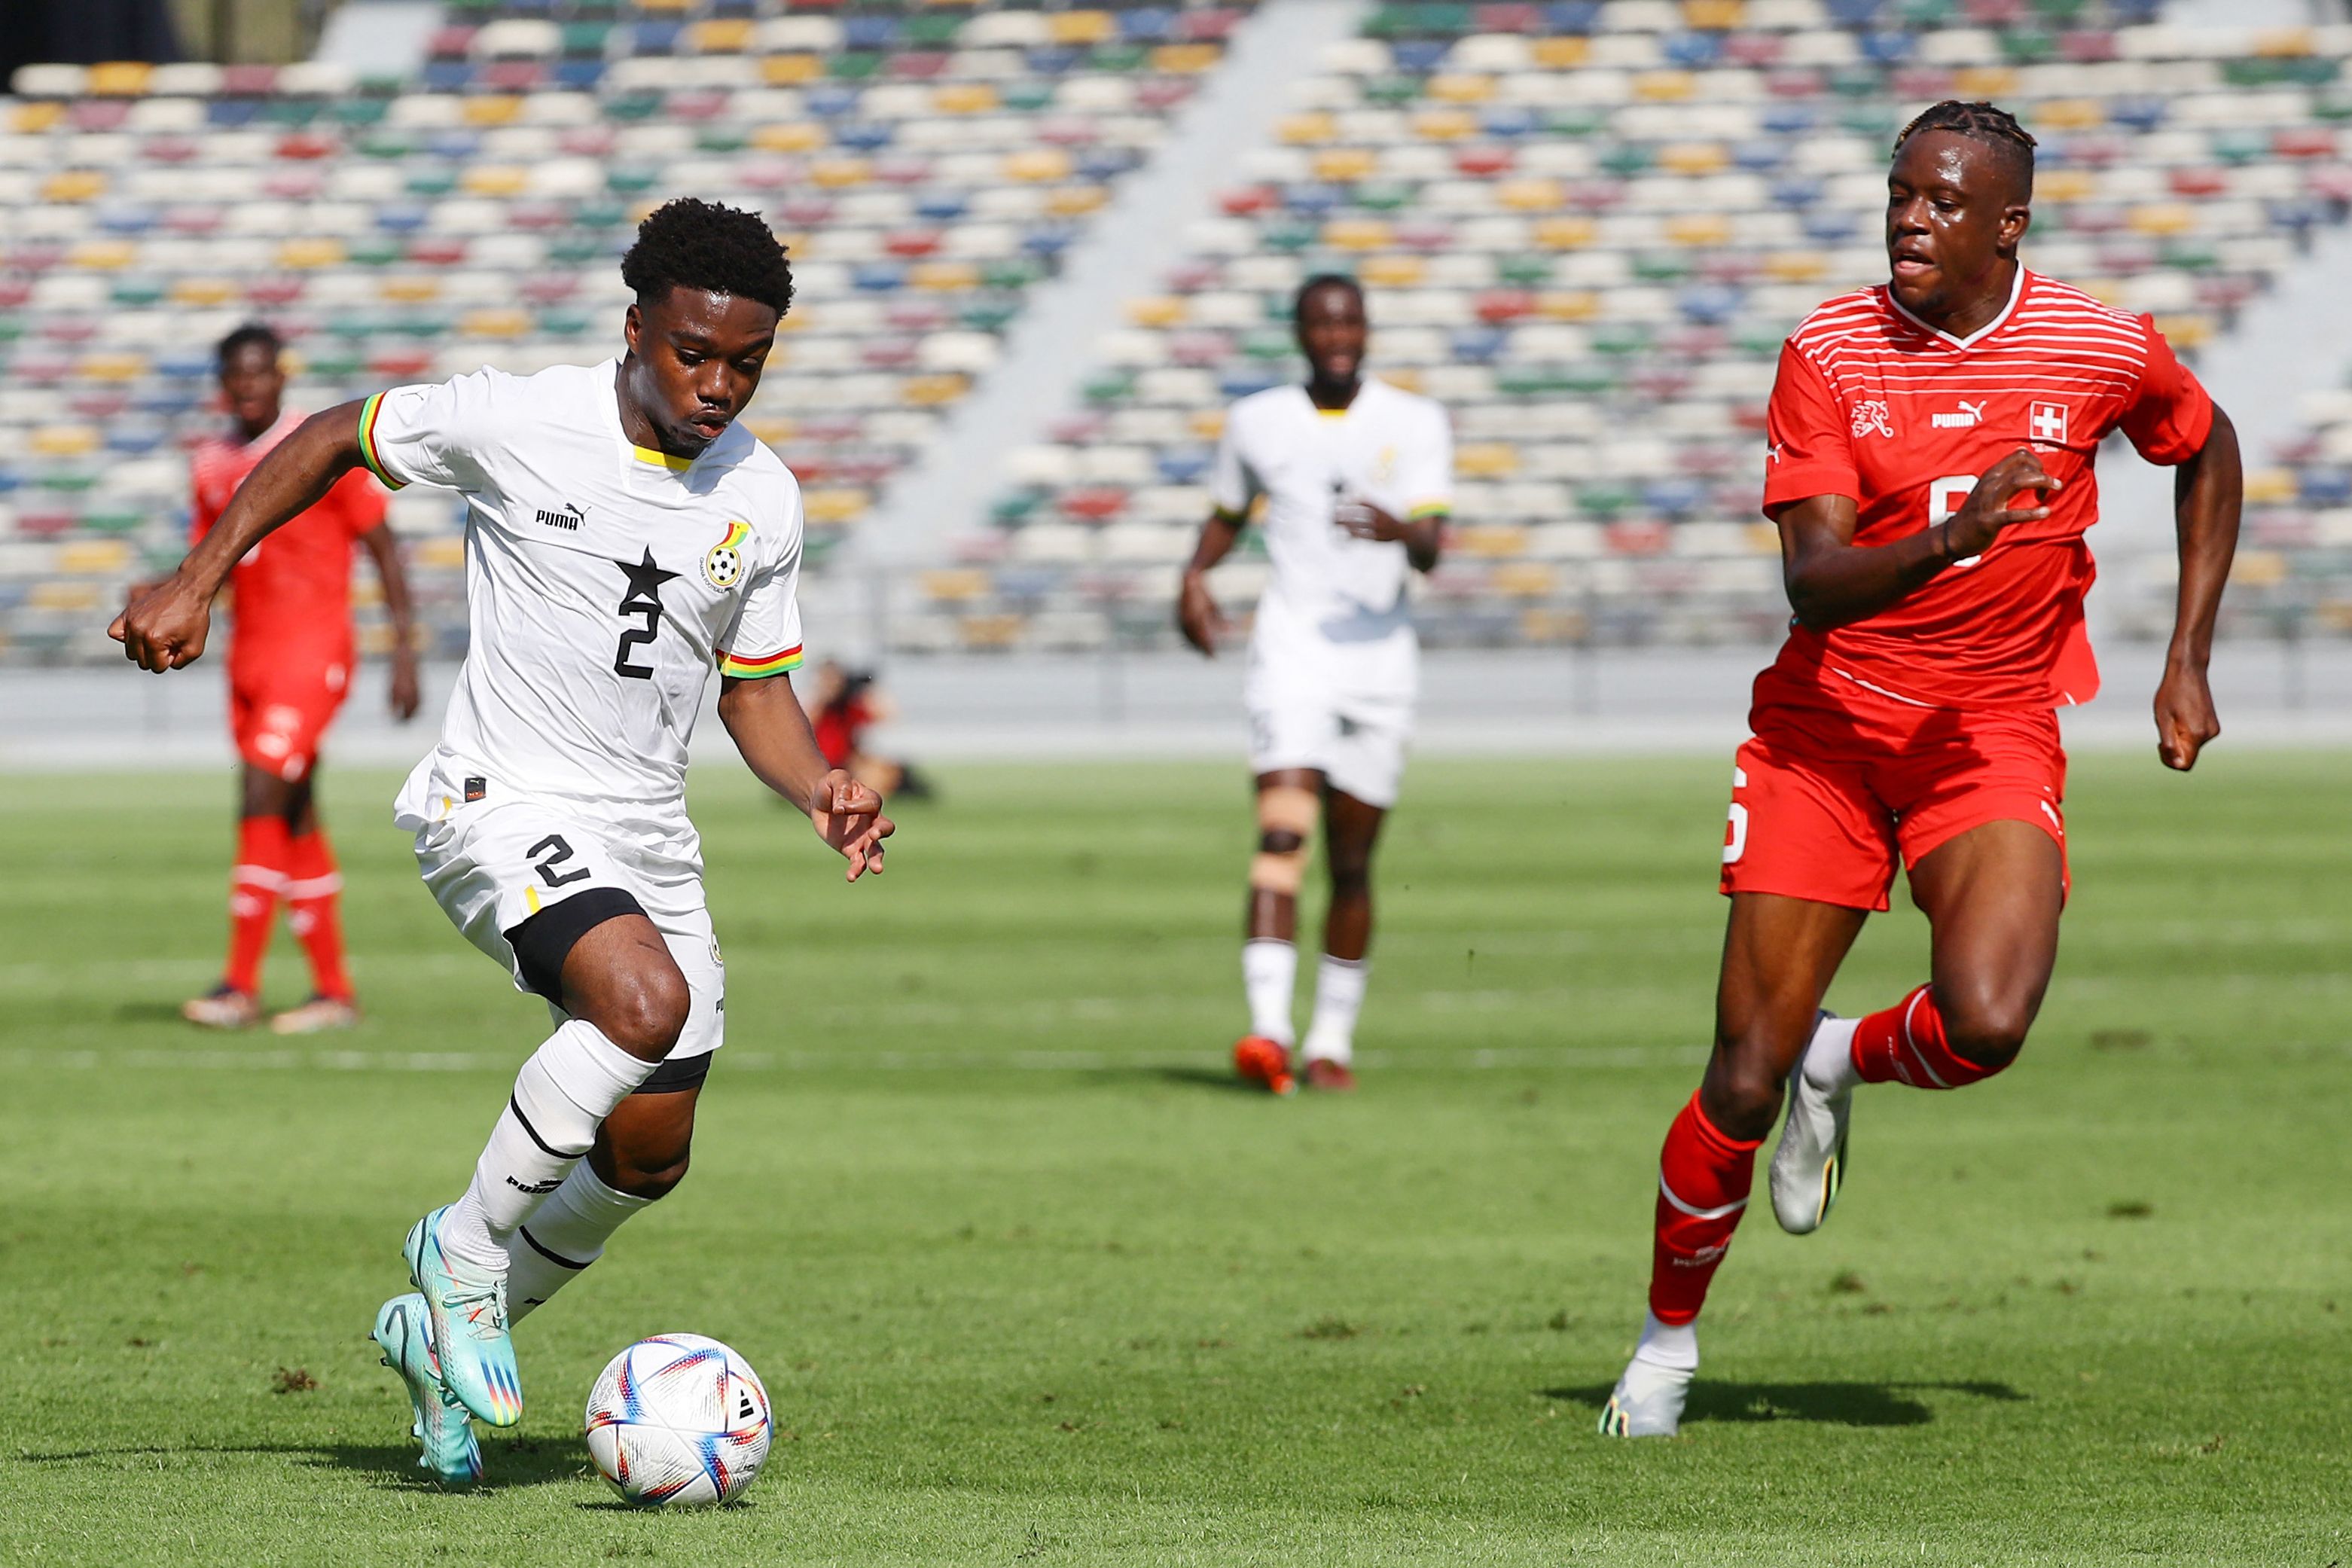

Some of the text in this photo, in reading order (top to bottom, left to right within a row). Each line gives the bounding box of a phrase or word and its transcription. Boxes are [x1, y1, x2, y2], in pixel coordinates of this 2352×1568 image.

[1932, 413, 1975, 429] PUMA
[535, 509, 578, 531] PUMA
[614, 601, 662, 680] 2
[525, 834, 591, 888] 2
